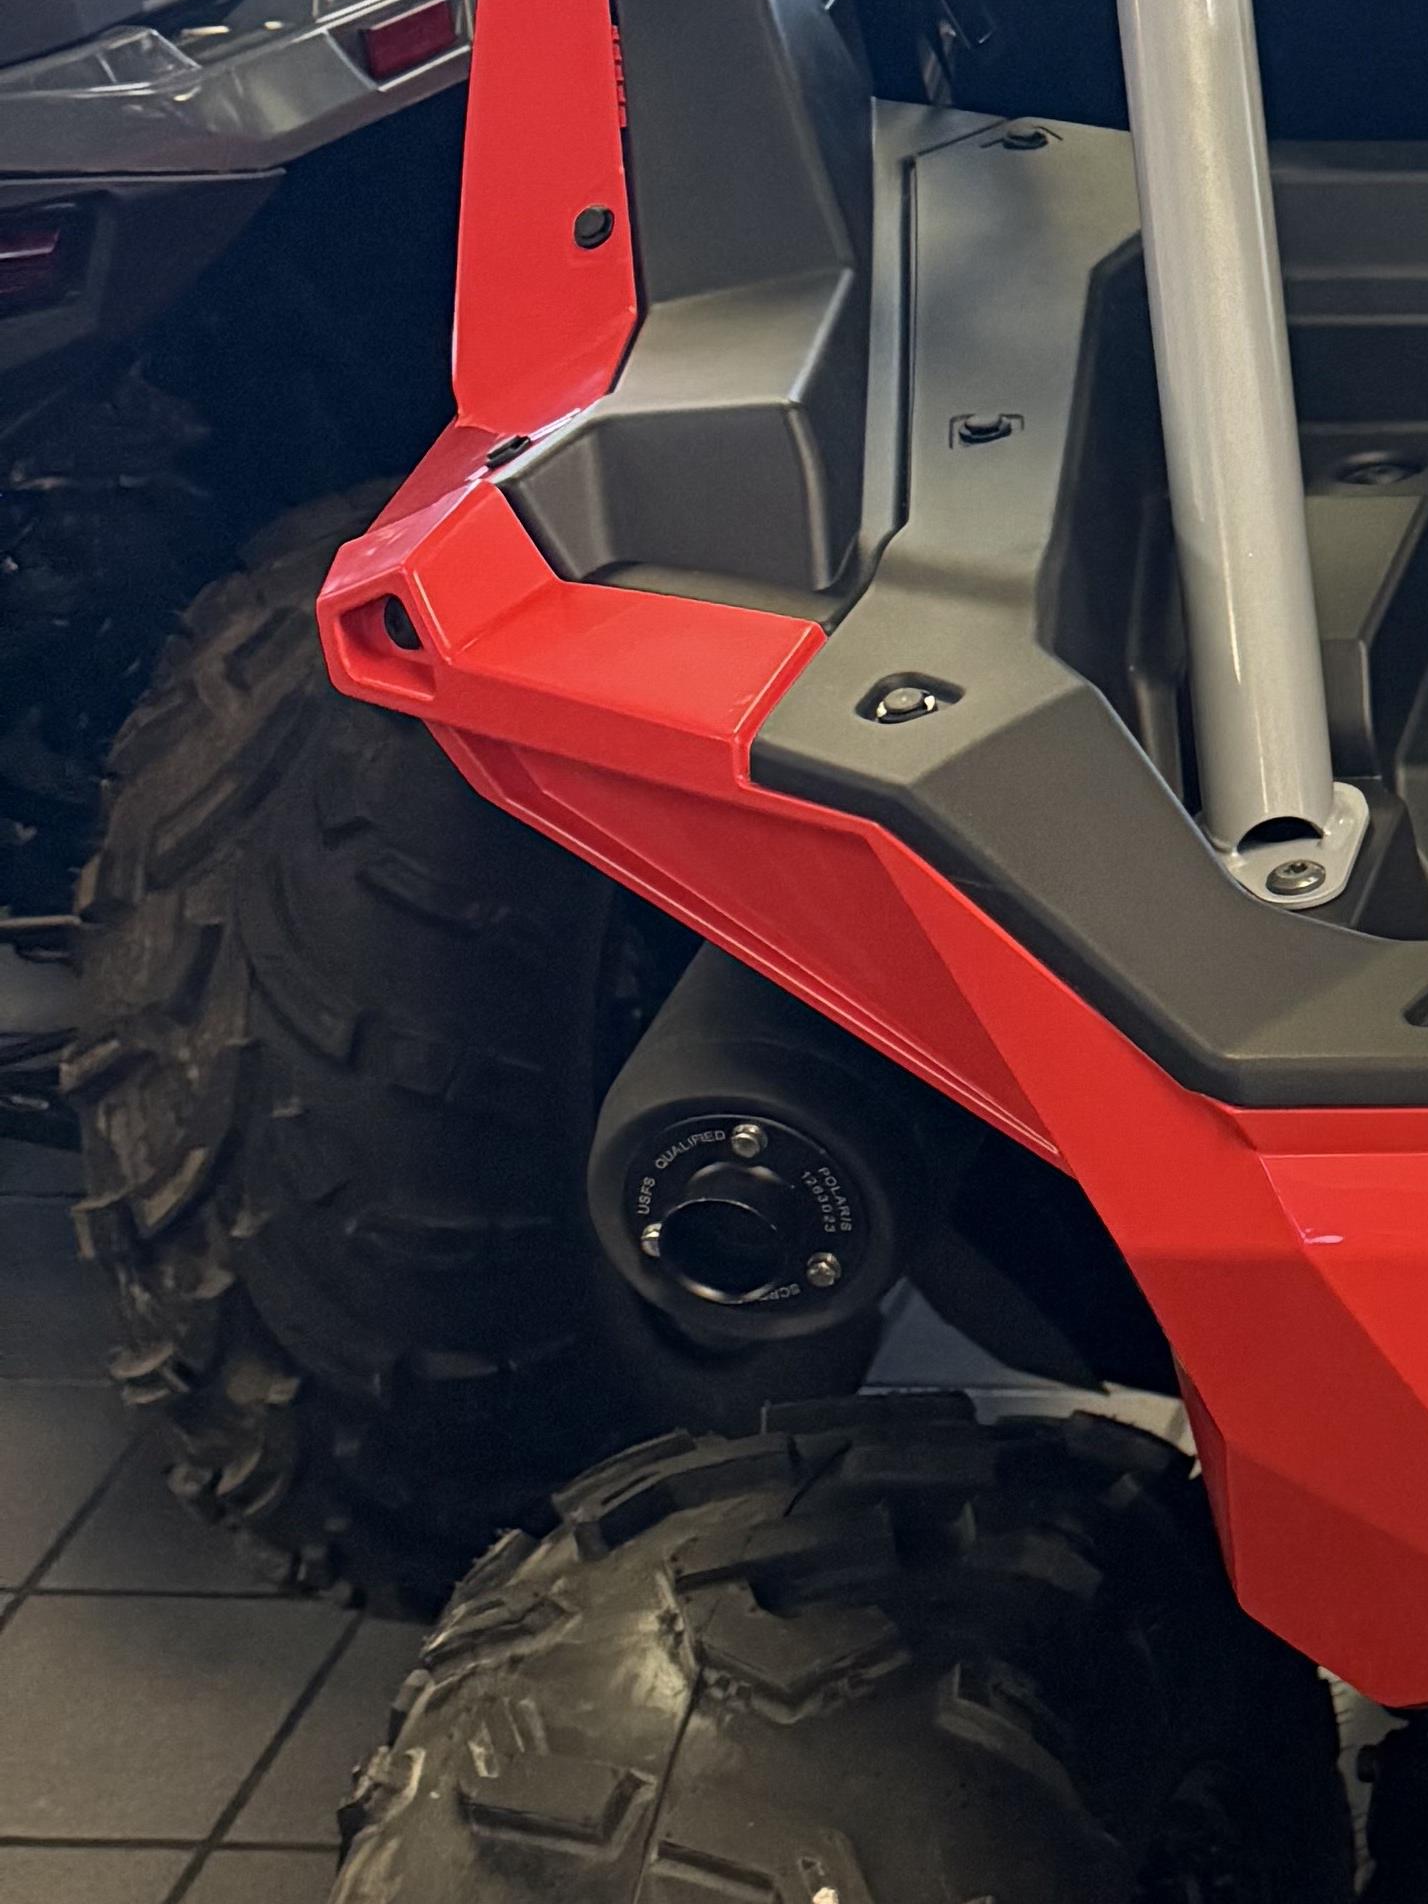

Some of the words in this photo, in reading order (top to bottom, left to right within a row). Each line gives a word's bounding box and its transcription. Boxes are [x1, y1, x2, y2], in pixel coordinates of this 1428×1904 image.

[636, 1176, 656, 1216] USFS
[655, 1129, 727, 1170] QUALIFIED
[817, 1166, 852, 1232] POLARIS
